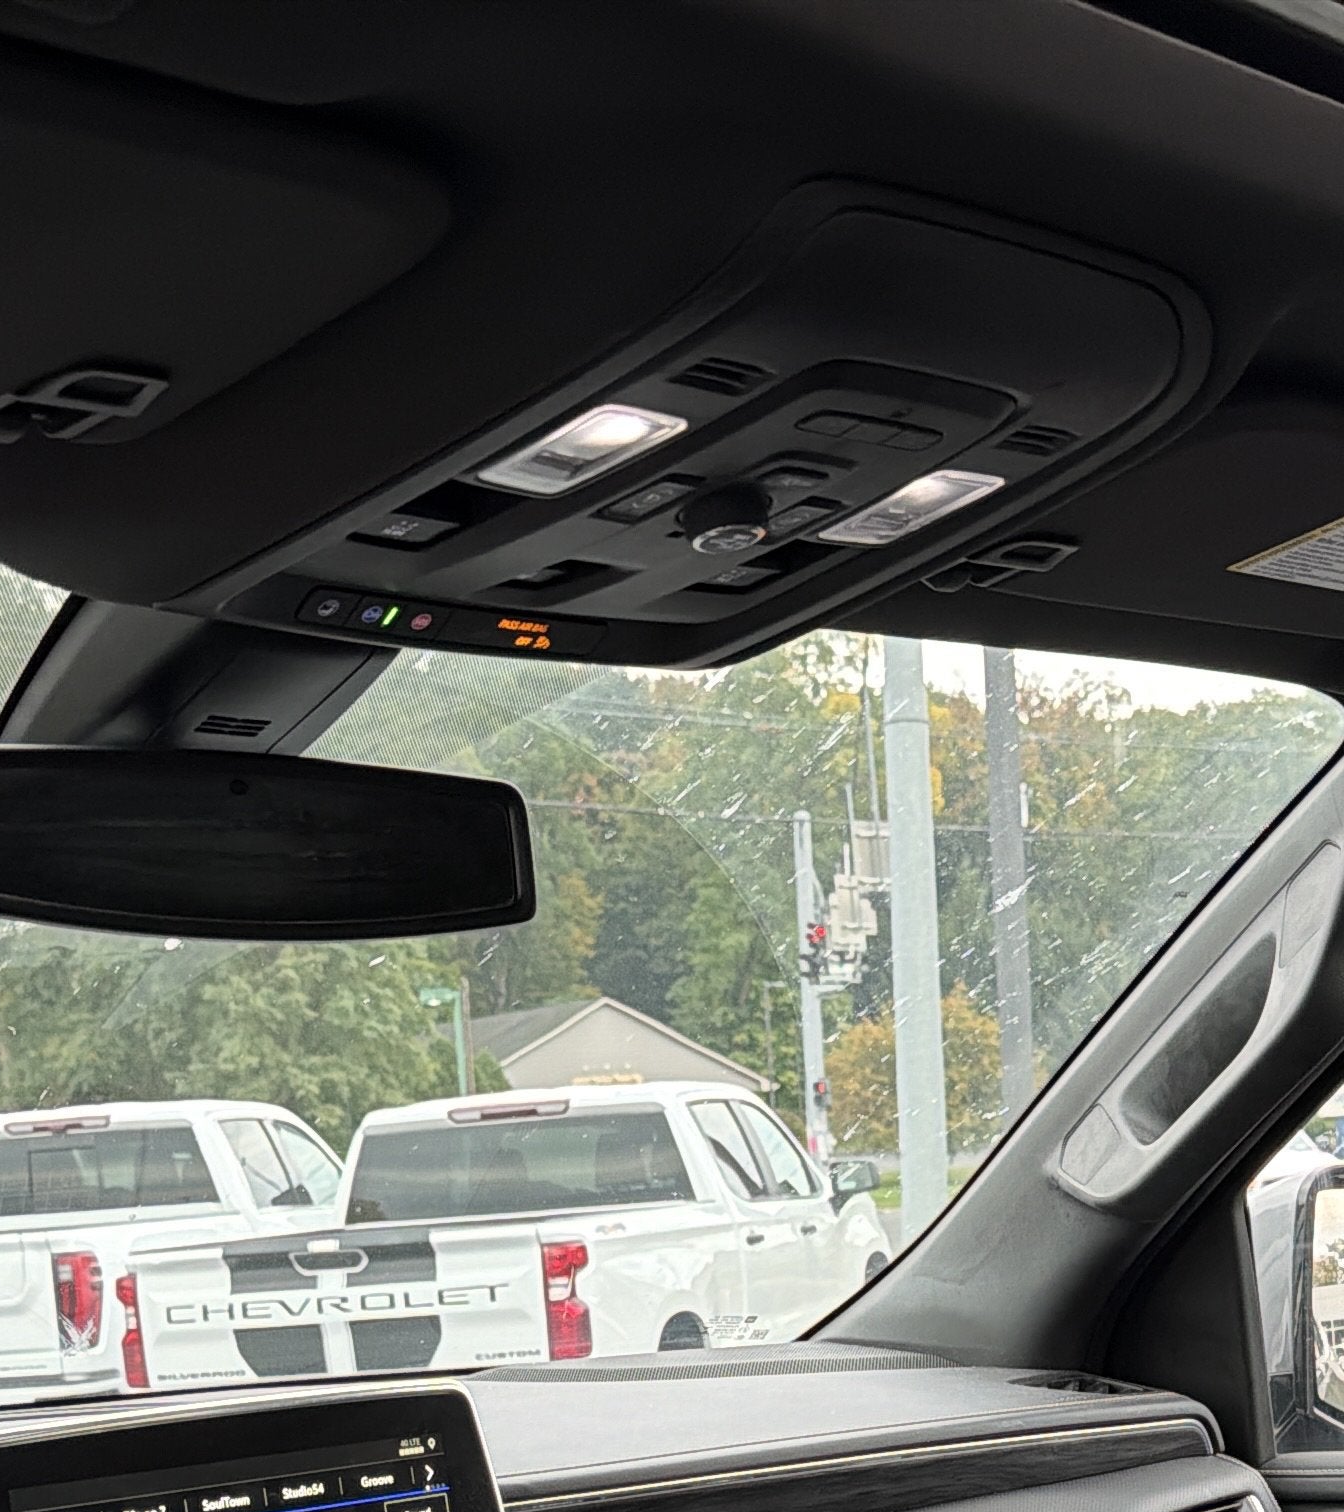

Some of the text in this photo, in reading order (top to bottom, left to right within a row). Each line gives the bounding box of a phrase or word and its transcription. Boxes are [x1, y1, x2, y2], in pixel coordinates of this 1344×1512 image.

[164, 1283, 510, 1326] CHEVROLET
[474, 1348, 542, 1361] CUSTOM
[156, 1368, 246, 1382] SILVERADO
[360, 1474, 394, 1488] Groove
[282, 1483, 325, 1500] Studio54
[201, 1495, 251, 1512] SoulTown
